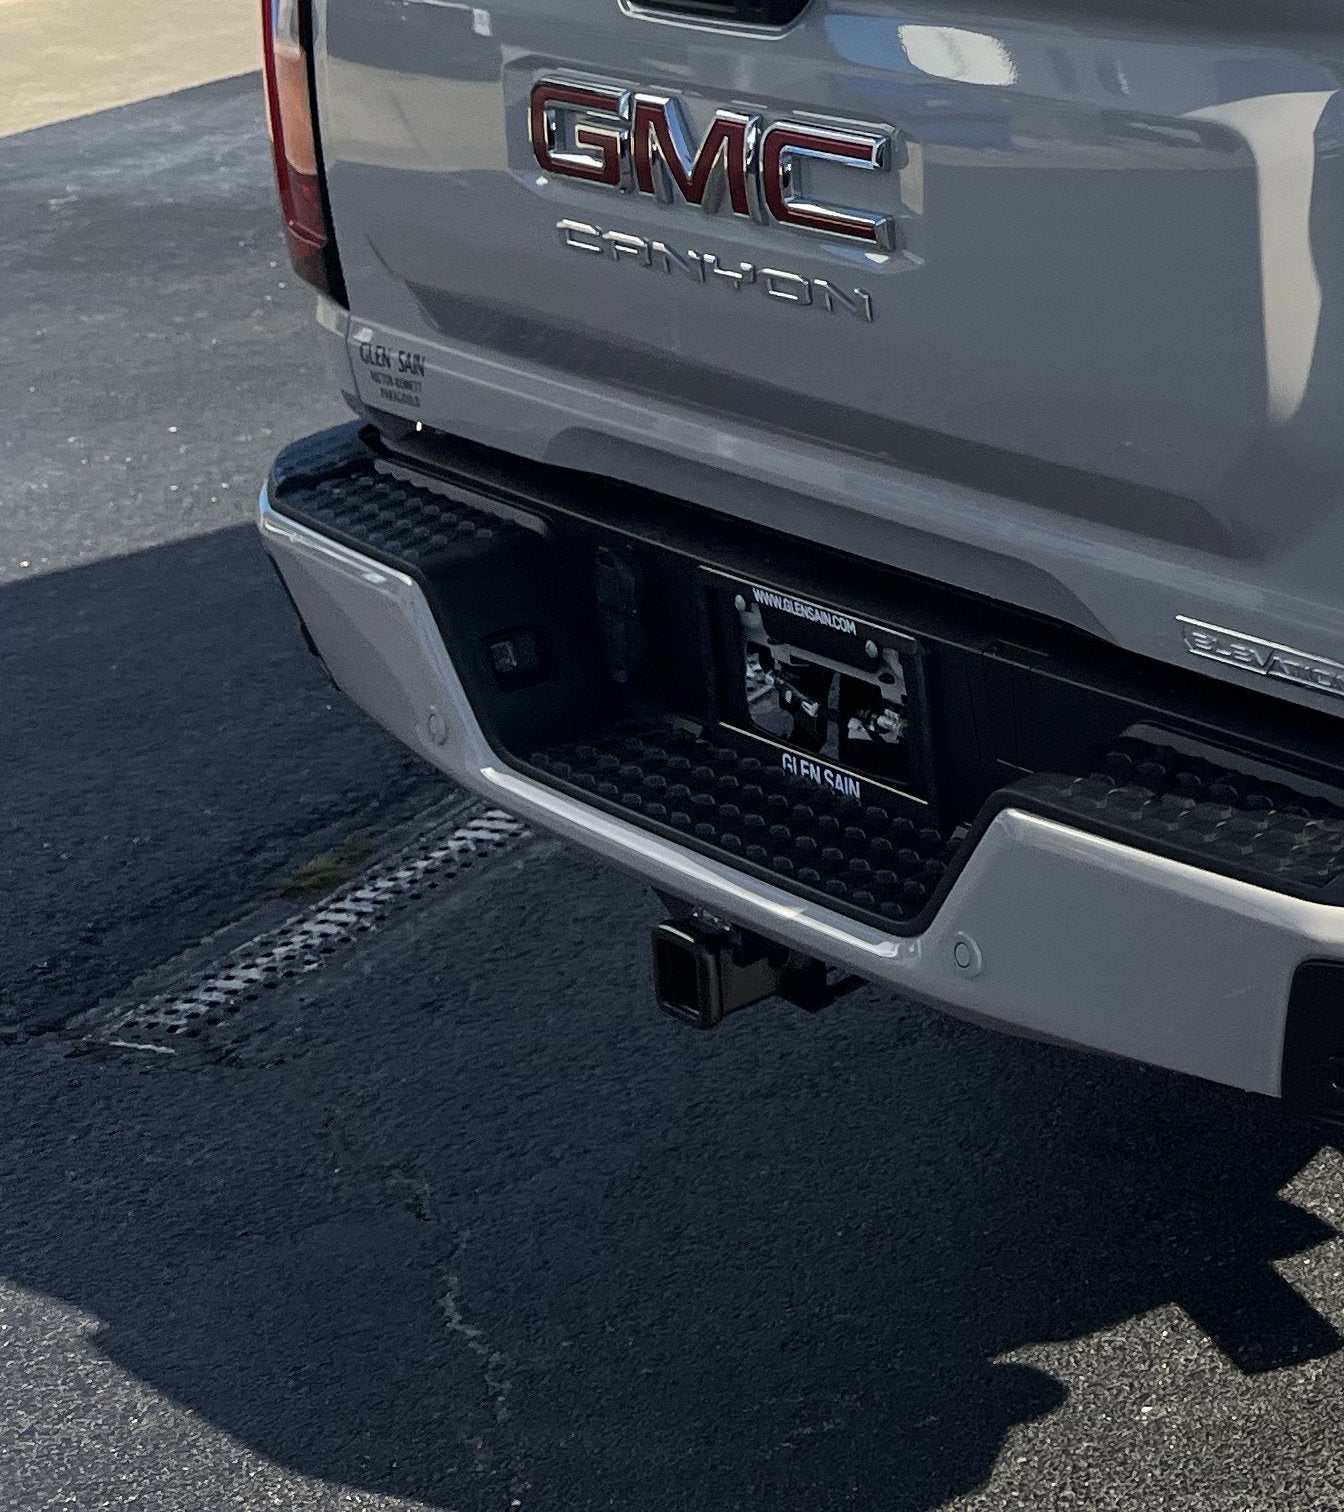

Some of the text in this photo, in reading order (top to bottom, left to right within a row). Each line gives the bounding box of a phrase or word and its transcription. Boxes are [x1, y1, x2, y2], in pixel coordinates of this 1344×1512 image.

[528, 73, 896, 253] GMC
[556, 217, 875, 323] CANYON
[360, 341, 426, 377] GLEN SAIN
[752, 586, 858, 636] WWW.GLENSAIN.COM
